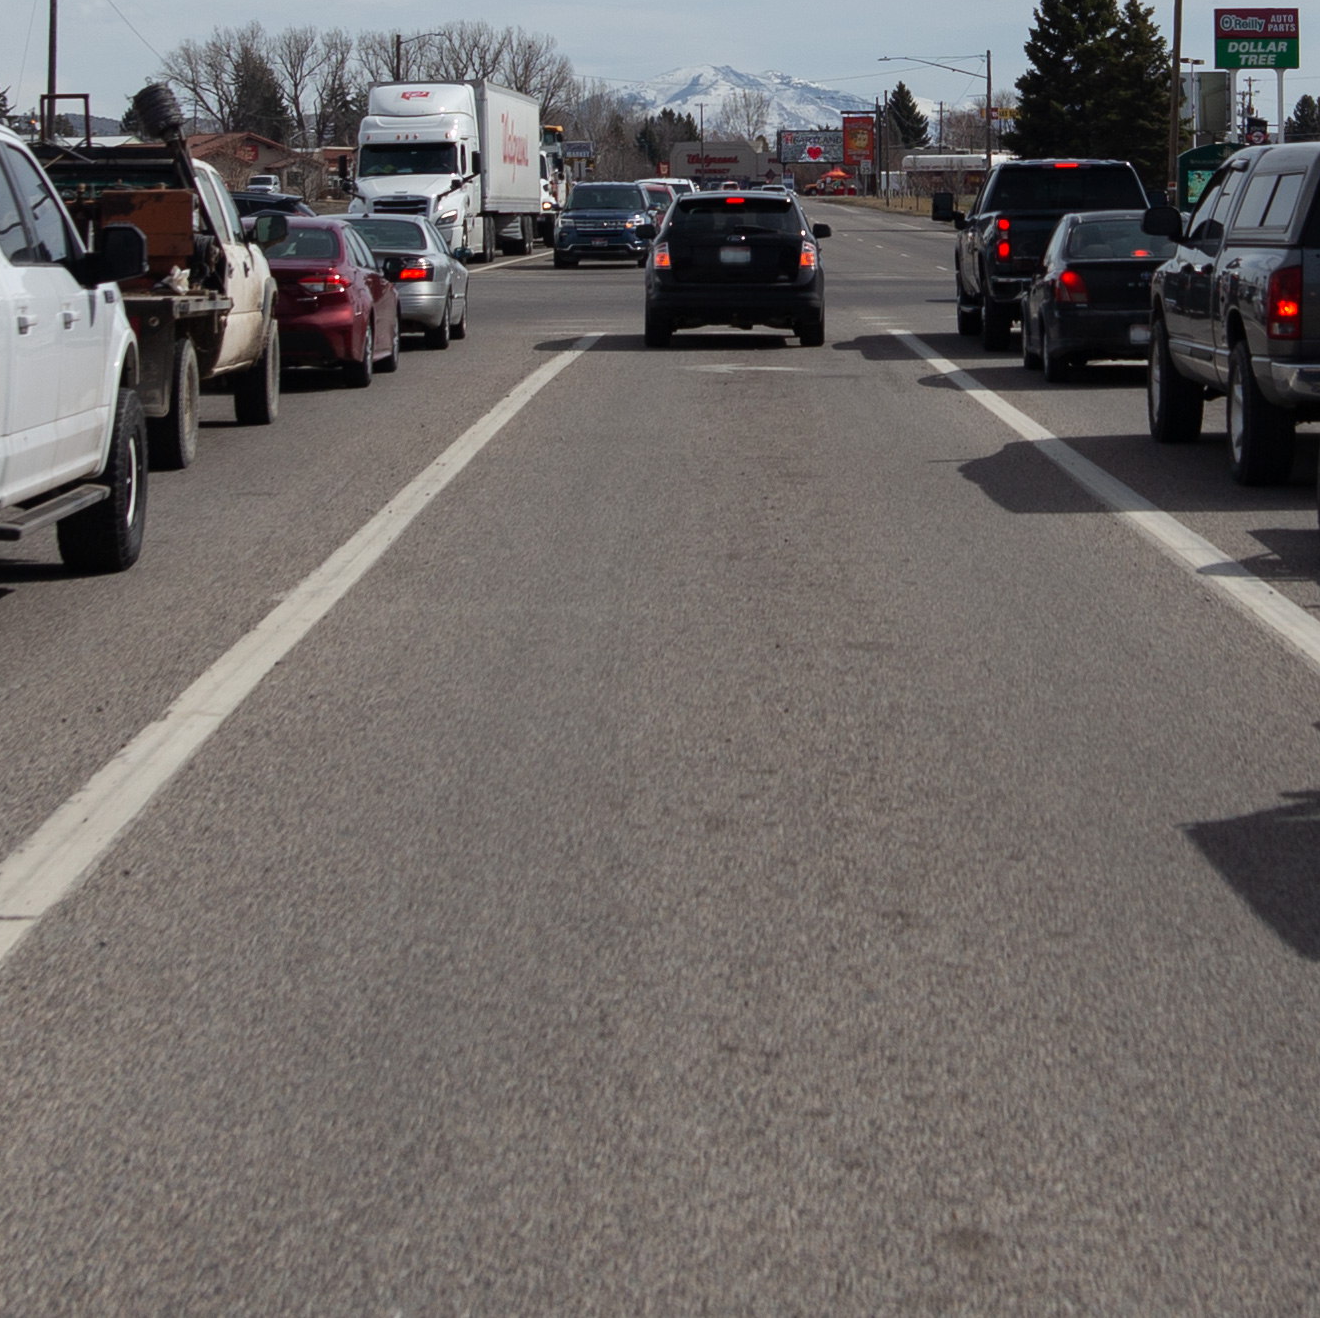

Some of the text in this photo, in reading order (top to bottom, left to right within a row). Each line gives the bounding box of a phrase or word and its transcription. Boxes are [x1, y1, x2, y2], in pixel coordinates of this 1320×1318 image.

[1220, 14, 1265, 32] O'Reilly
[1270, 14, 1294, 23] AUTO
[1267, 23, 1296, 32] PARTS
[1227, 42, 1288, 53] DOLLAR
[1239, 54, 1277, 66] TREE
